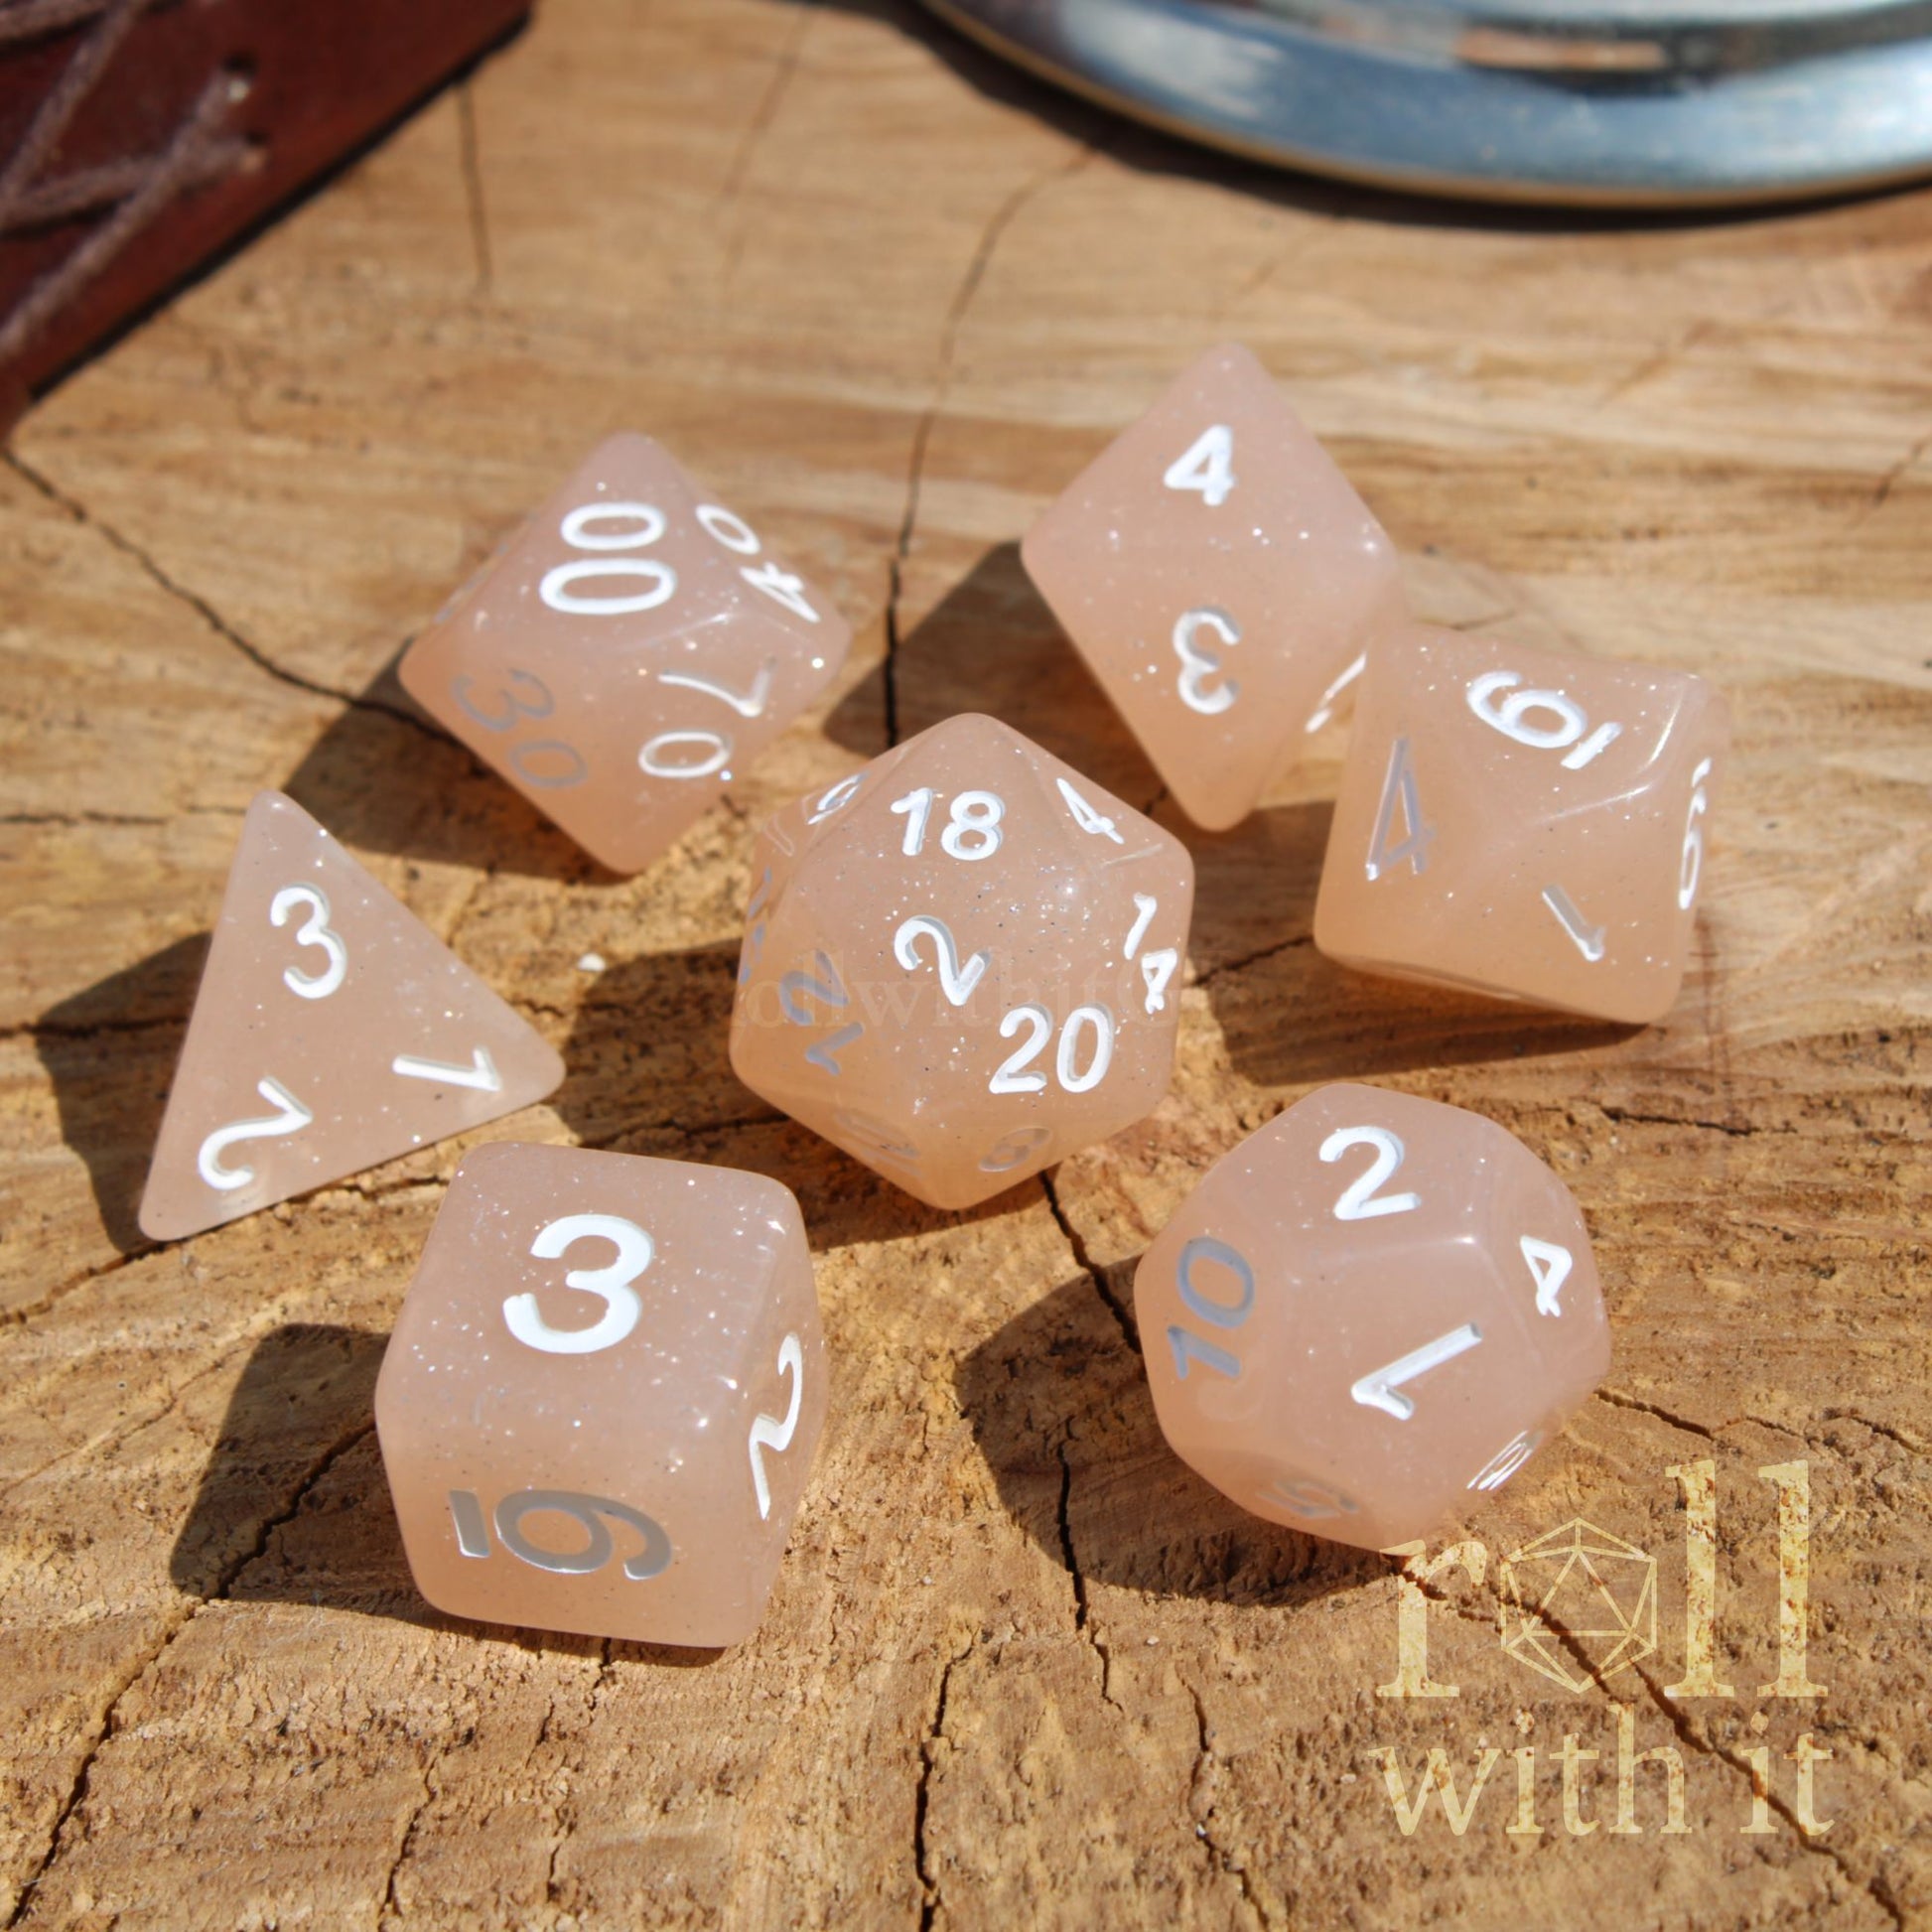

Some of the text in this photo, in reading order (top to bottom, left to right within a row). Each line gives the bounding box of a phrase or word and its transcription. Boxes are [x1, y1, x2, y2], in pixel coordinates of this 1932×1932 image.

[1164, 425, 1237, 507] 4
[539, 501, 677, 615] 00
[1173, 606, 1241, 716] 3
[452, 667, 588, 788] 30
[891, 787, 1005, 861] 18
[1056, 777, 1124, 845] 4
[1365, 738, 1438, 882] 4
[269, 883, 347, 1000] 3
[894, 914, 992, 1007] 2
[1542, 886, 1606, 962] 1
[392, 1046, 502, 1092] 1
[989, 1002, 1113, 1093] 20
[199, 1076, 314, 1190] 2
[1319, 1125, 1423, 1221] 2
[502, 1213, 655, 1355] 3
[1168, 1236, 1255, 1381] 10
[1519, 1235, 1574, 1318] 4
[1350, 1321, 1483, 1422] 1
